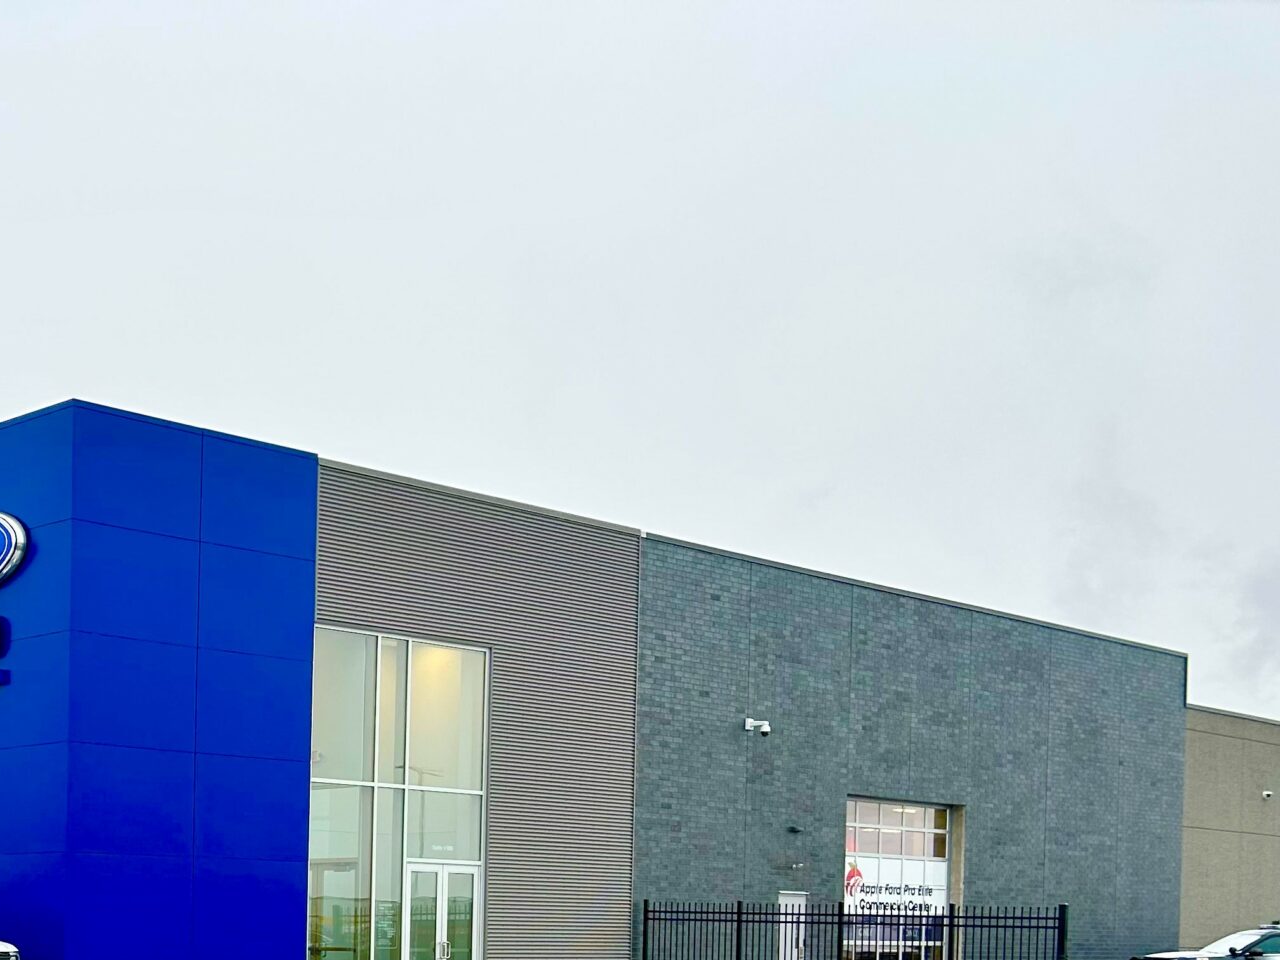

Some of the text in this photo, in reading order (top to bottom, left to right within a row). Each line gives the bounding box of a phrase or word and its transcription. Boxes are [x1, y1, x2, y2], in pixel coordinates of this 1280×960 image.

[860, 883, 882, 897] Apple
[885, 884, 901, 895] Ford
[904, 885, 916, 895] Pro
